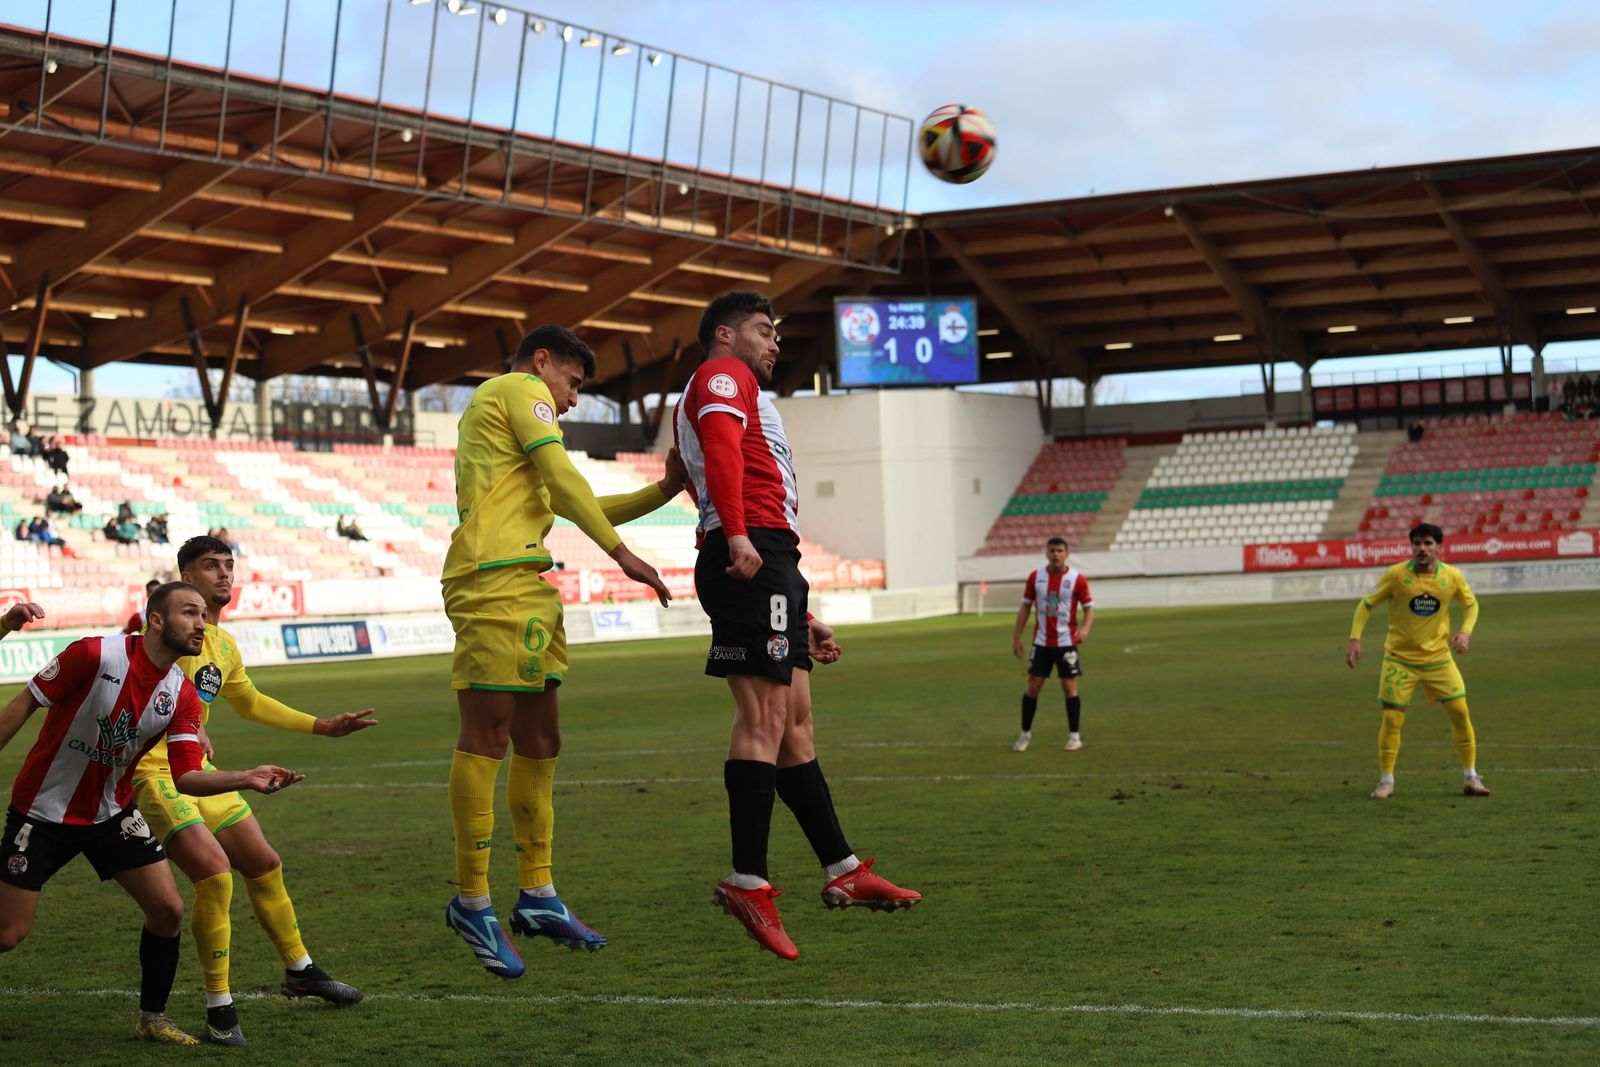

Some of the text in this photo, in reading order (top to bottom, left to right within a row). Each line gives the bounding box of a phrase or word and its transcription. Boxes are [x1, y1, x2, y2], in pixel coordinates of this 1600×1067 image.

[883, 336, 933, 364] 1 0
[770, 594, 788, 632] 8
[524, 617, 545, 652] 6
[201, 670, 221, 685] Estrella
[14, 822, 33, 851] 4
